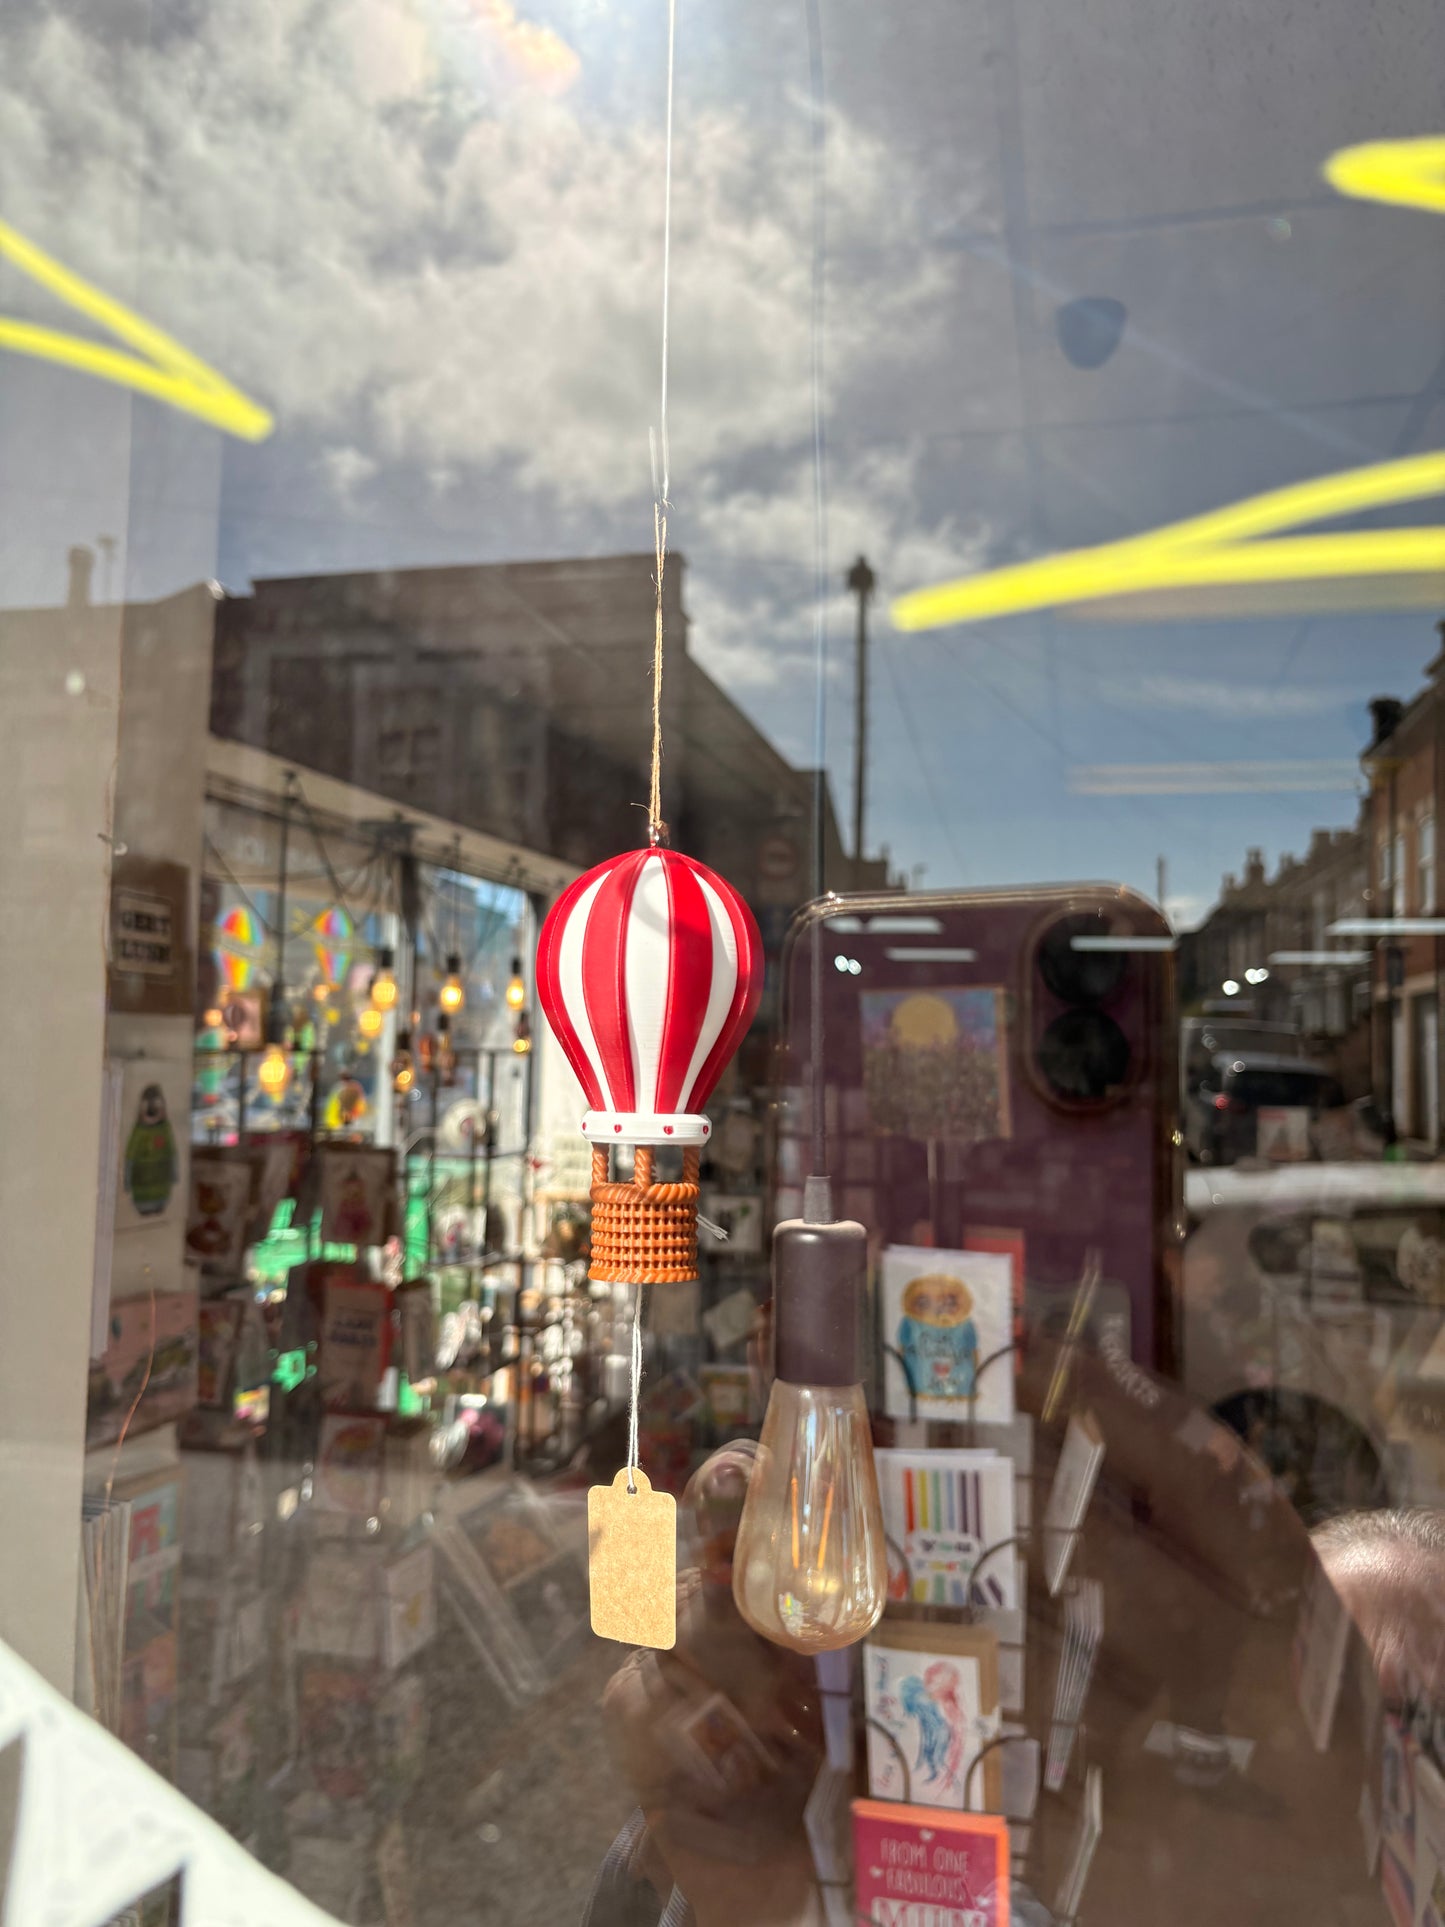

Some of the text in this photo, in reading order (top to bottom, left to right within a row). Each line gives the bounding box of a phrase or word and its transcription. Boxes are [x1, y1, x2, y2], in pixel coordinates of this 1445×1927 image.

[880, 1837, 968, 1875] FROM ONE
[886, 1867, 967, 1902] FABULOUS
